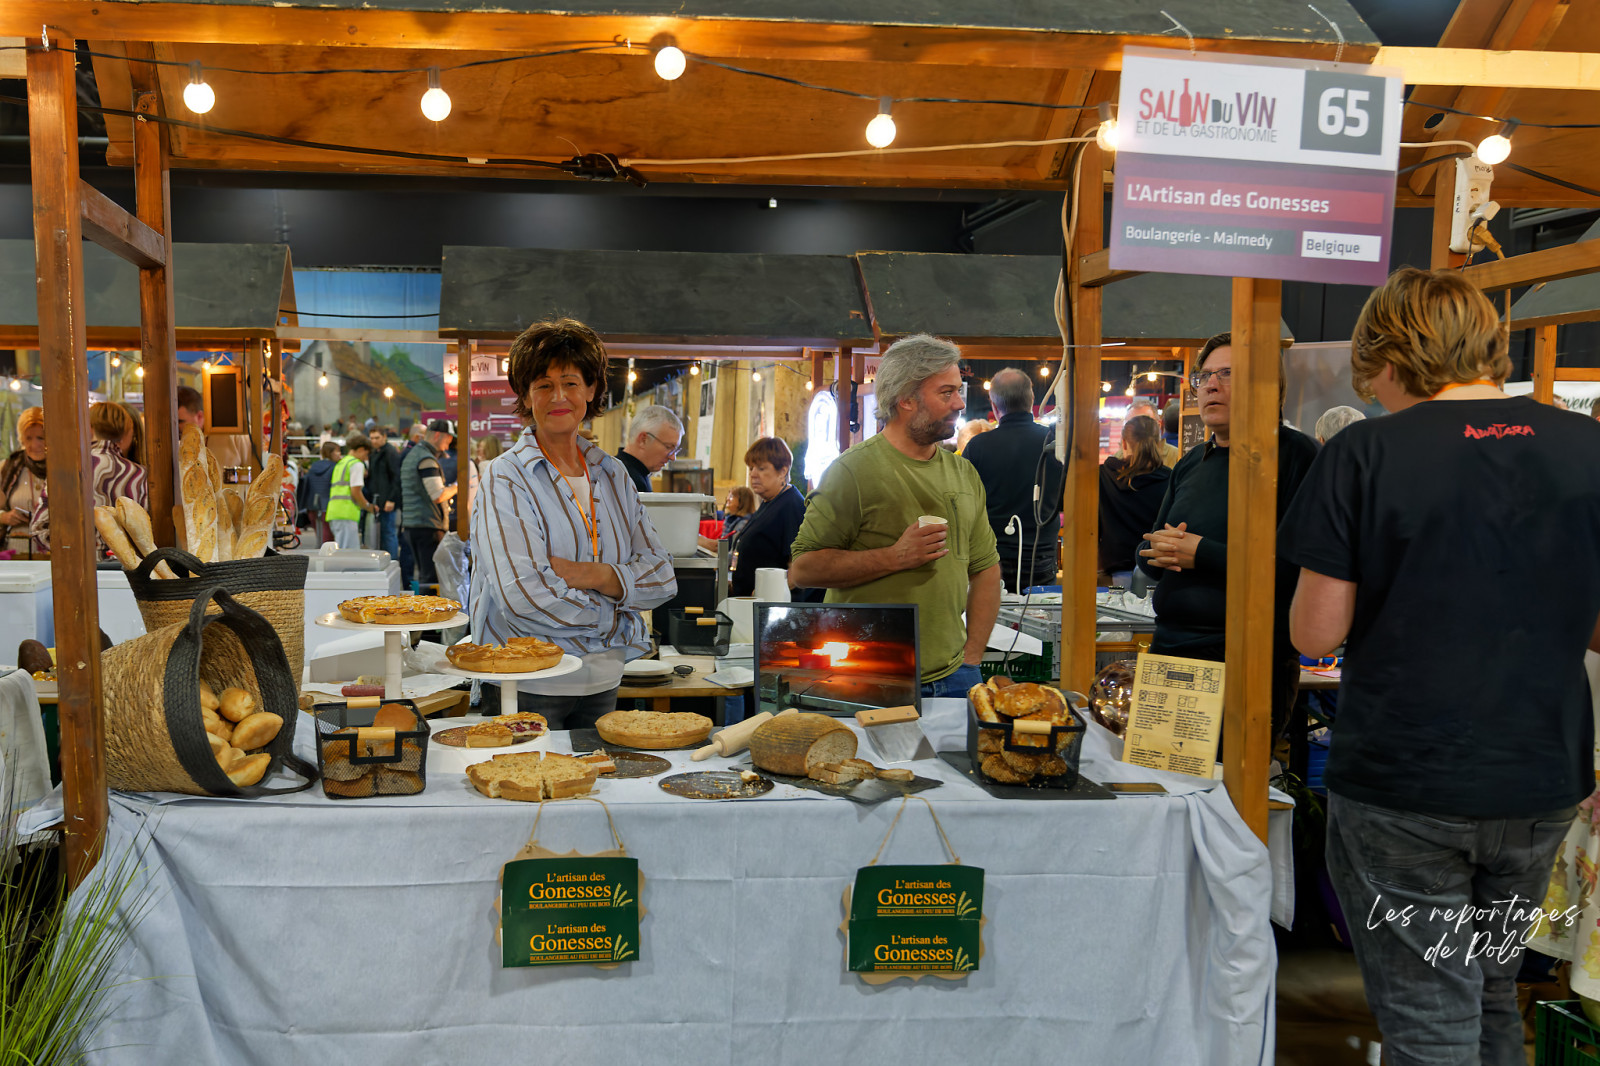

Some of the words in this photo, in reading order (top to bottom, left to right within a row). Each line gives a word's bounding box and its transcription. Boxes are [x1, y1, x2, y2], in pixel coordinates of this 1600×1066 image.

[1211, 99, 1233, 123] DU
[1235, 92, 1276, 129] VIN
[1317, 87, 1371, 137] 65
[1136, 121, 1150, 134] ET
[1153, 122, 1169, 136] DE
[1173, 123, 1187, 137] LA
[1190, 125, 1277, 143] GASTRONOMIE
[1126, 184, 1205, 205] L'Artisan
[1210, 189, 1241, 208] des
[1246, 192, 1330, 213] Gonesses
[1125, 226, 1201, 245] Boulangerie
[1213, 232, 1273, 250] Malmedy
[1306, 238, 1360, 256] Belgique
[547, 872, 587, 882] L'artisan
[589, 872, 606, 881] des
[896, 880, 934, 889] L'artisan
[936, 879, 952, 888] des
[529, 883, 612, 899] Gonesses
[878, 888, 957, 905] Gonesses
[547, 924, 588, 934] L'artisan
[590, 923, 606, 932] des
[529, 934, 612, 951] Gonesses
[891, 935, 931, 944] L'artisan
[932, 934, 948, 944] des
[874, 944, 954, 961] Gonesses
